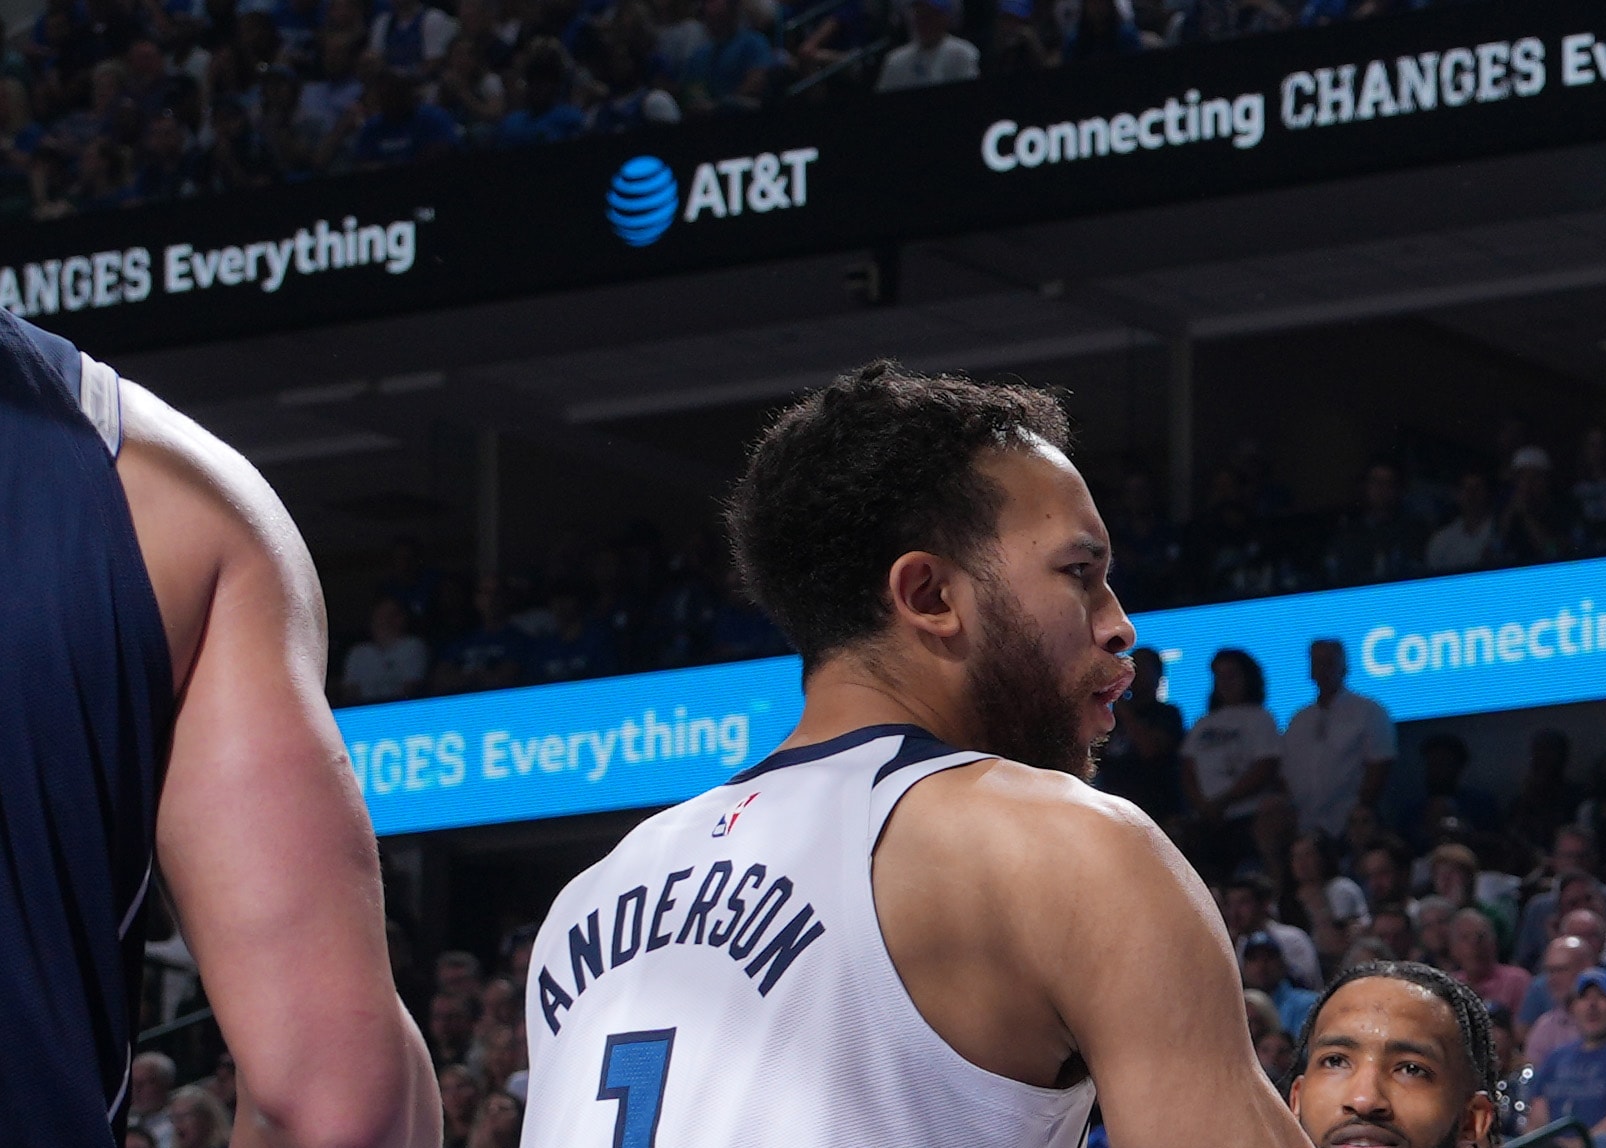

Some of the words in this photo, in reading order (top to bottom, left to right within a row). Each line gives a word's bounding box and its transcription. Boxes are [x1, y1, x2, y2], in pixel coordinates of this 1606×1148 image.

[981, 89, 1265, 172] Connecting
[1280, 36, 1546, 130] CHANGES
[684, 147, 819, 223] AT&T
[164, 215, 416, 293] Everything
[481, 706, 749, 782] Everything
[537, 859, 825, 1036] ANDERSON
